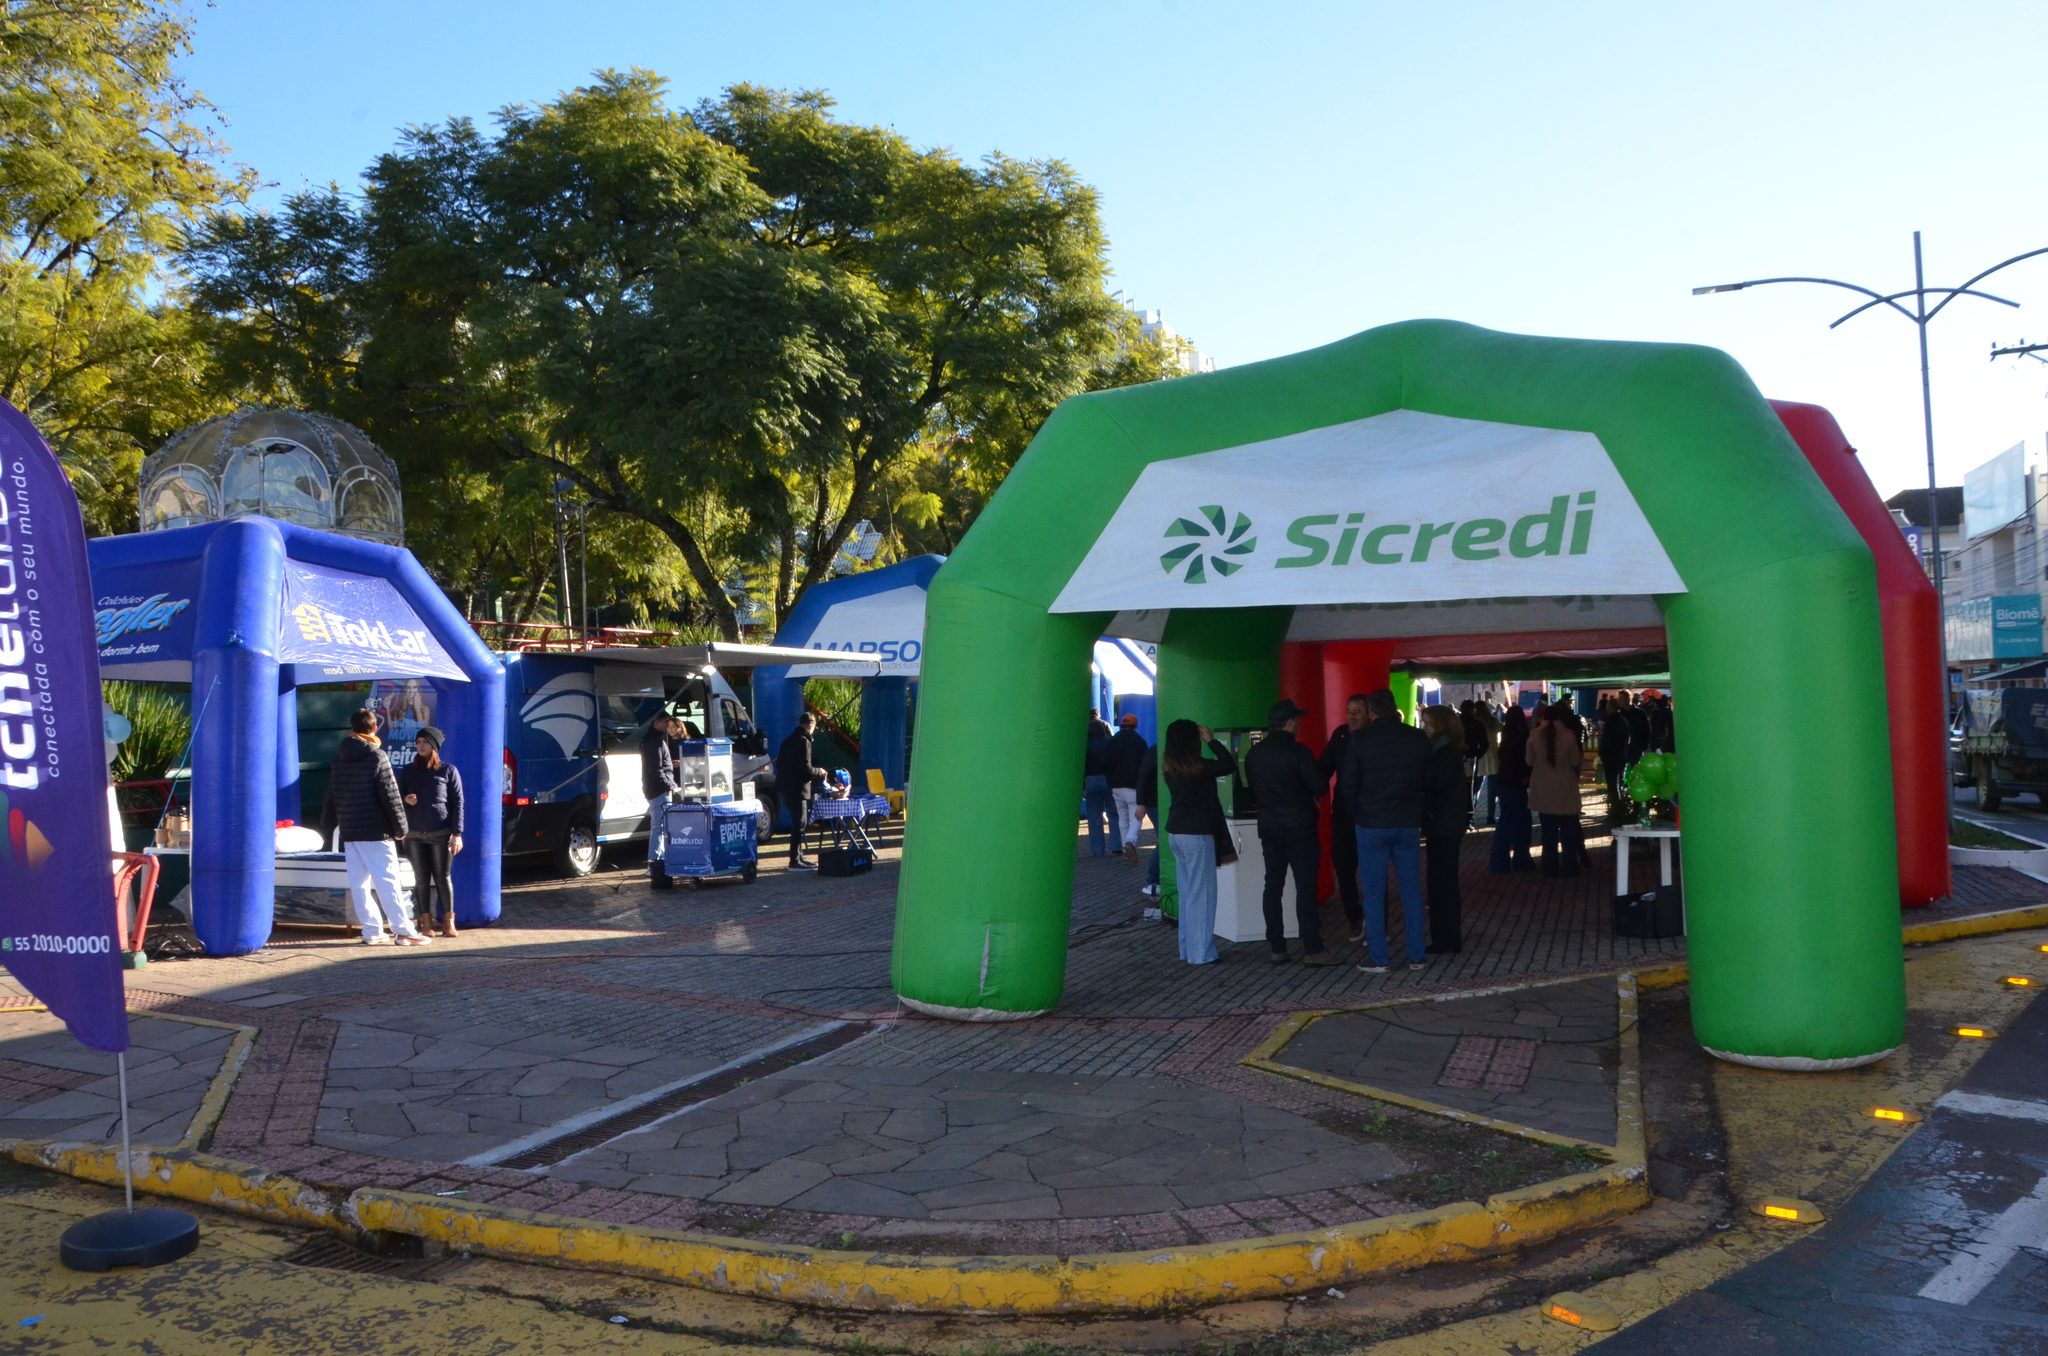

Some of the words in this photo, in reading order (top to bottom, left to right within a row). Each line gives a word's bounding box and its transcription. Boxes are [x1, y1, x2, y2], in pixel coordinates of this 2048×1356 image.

[11, 456, 33, 535] mundo.
[1274, 490, 1596, 569] Sicredi
[23, 544, 37, 581] seu
[26, 588, 39, 601] o
[27, 608, 45, 655] com
[101, 644, 137, 657] dormir
[136, 642, 160, 654] bem
[35, 663, 60, 778] conectada
[720, 821, 748, 834] PIPOCA
[720, 832, 727, 844] E
[727, 831, 748, 843] WI-FI
[671, 837, 704, 846] tcheturbo
[15, 937, 31, 951] 55
[32, 934, 110, 954] 2010-0000
